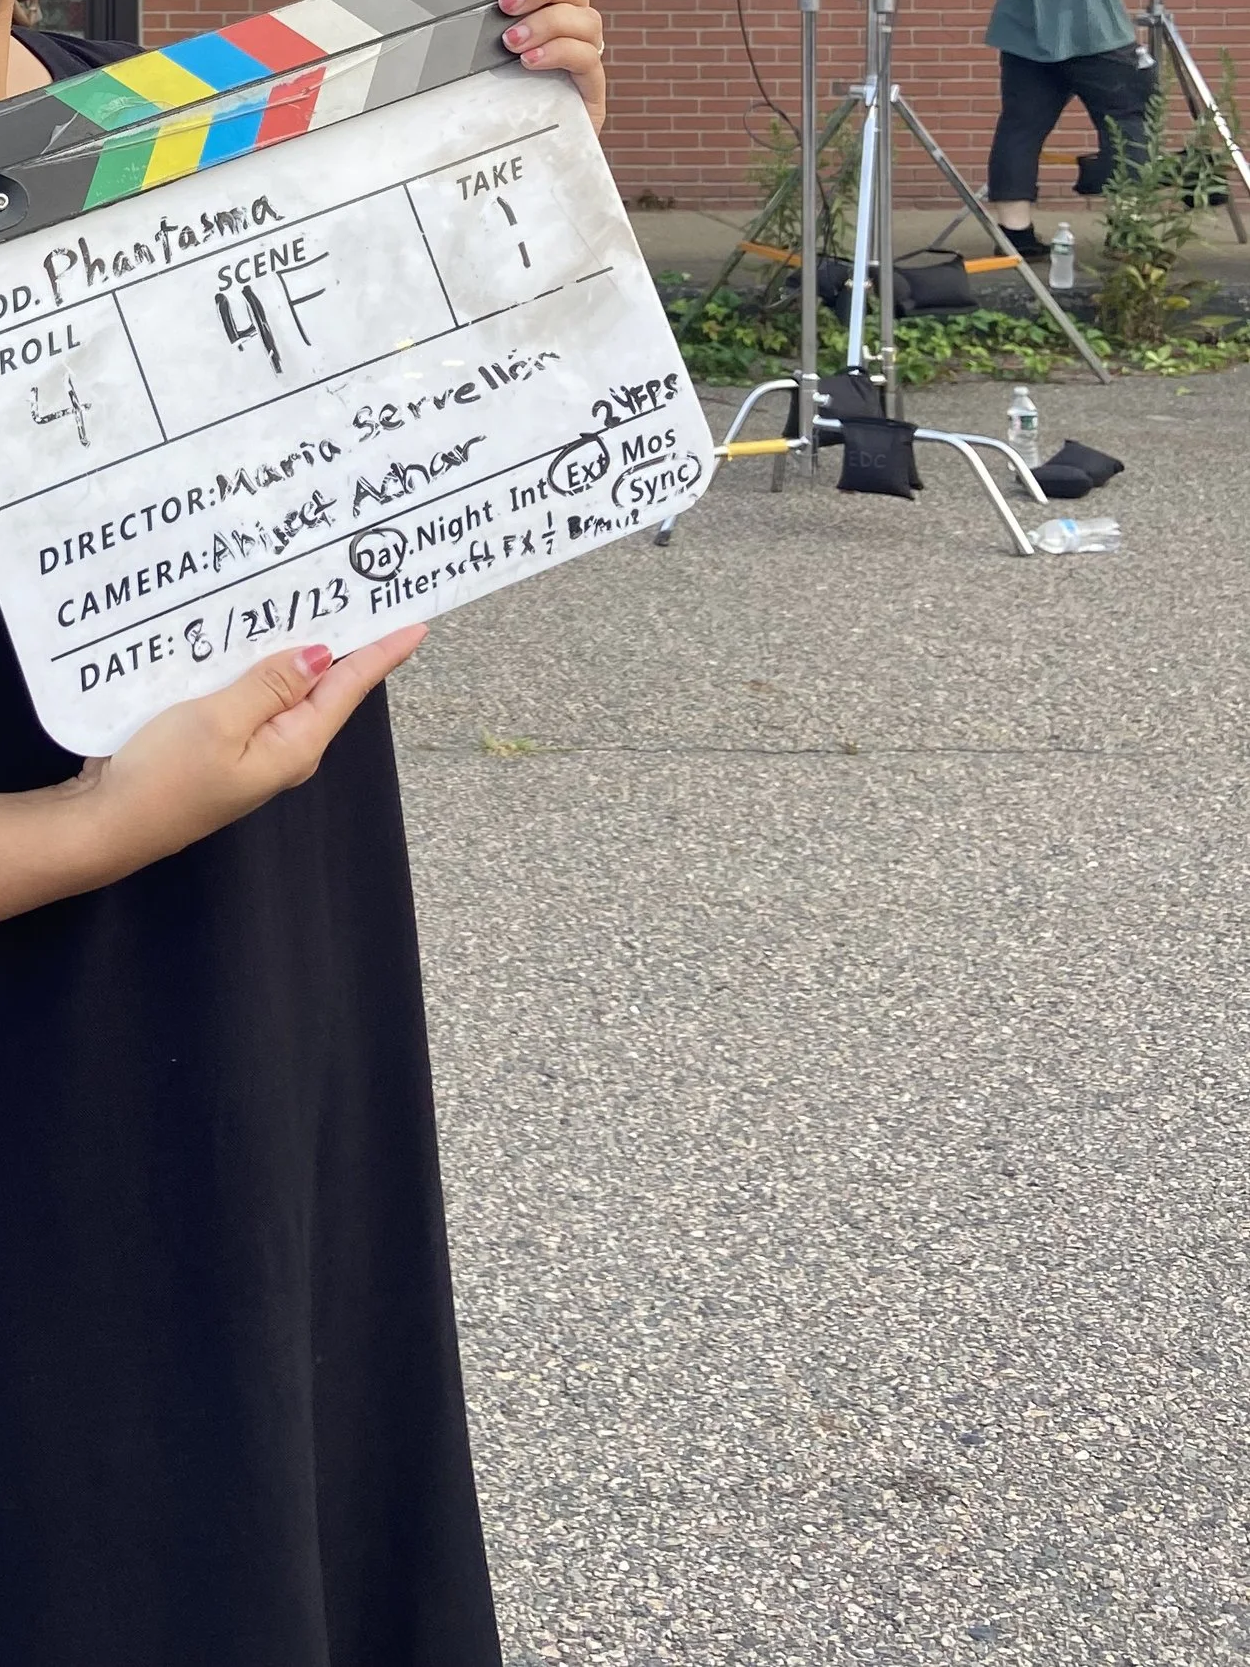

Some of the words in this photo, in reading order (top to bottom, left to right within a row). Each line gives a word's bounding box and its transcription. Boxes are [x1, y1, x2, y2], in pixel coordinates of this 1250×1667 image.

[455, 156, 524, 200] TAKE
[43, 195, 286, 307] Phantasma
[217, 237, 307, 292] SCENE
[0, 324, 81, 376] ROLL
[214, 250, 330, 375] 4F
[26, 362, 93, 447] 4
[509, 477, 548, 513] Int
[566, 453, 609, 489] Ext
[621, 428, 677, 466] Mos
[629, 463, 690, 505] Sync
[38, 486, 216, 575] DIRECTOR:
[56, 551, 209, 627] CAMERA:
[79, 635, 175, 693] DATE:
